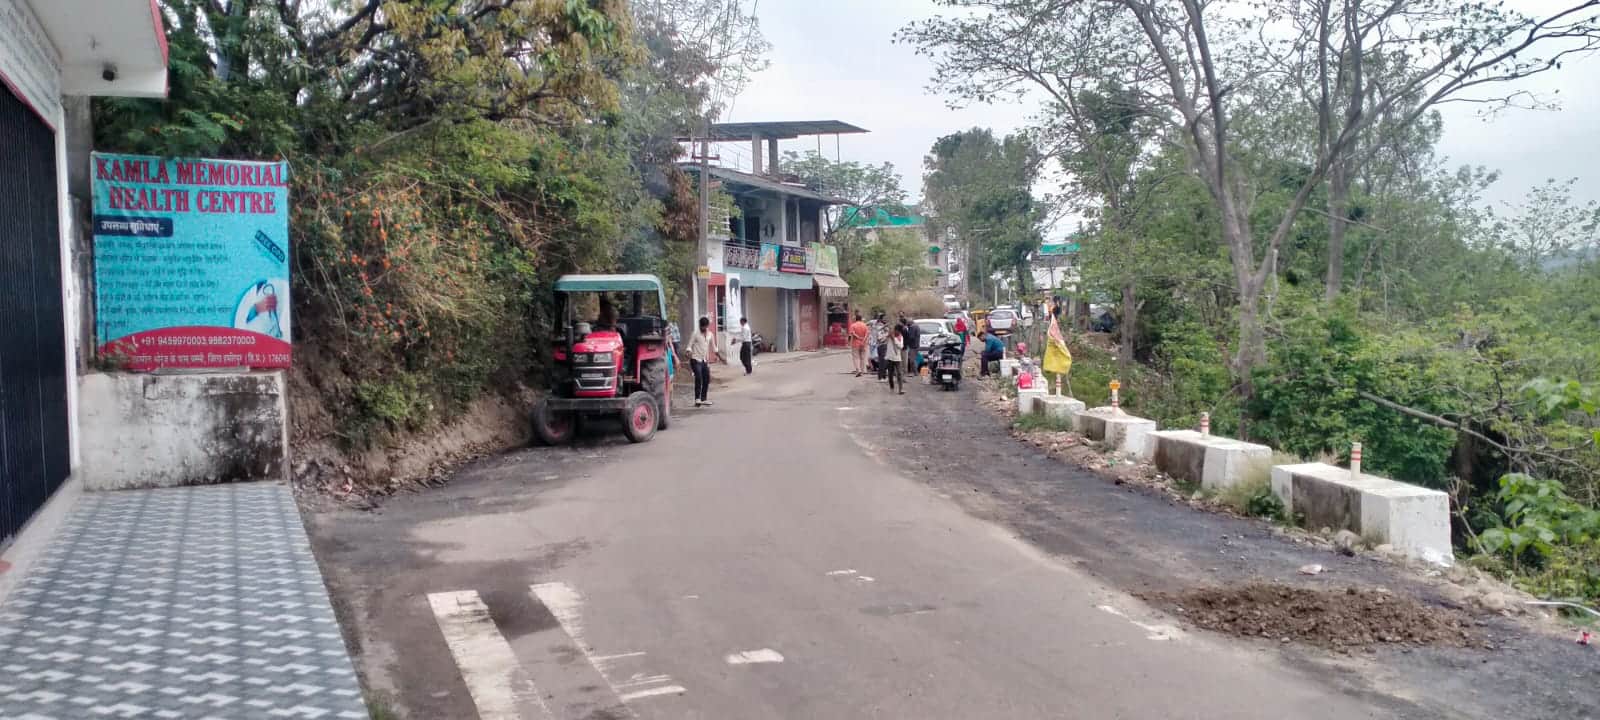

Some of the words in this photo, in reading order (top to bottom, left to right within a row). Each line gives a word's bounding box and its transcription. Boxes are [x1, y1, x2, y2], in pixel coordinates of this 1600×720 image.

[96, 157, 170, 184] KAMLA
[176, 160, 287, 187] MEMORIAL
[109, 186, 190, 212] HEALTH
[196, 191, 276, 214] CENTRE
[140, 335, 155, 346] +91
